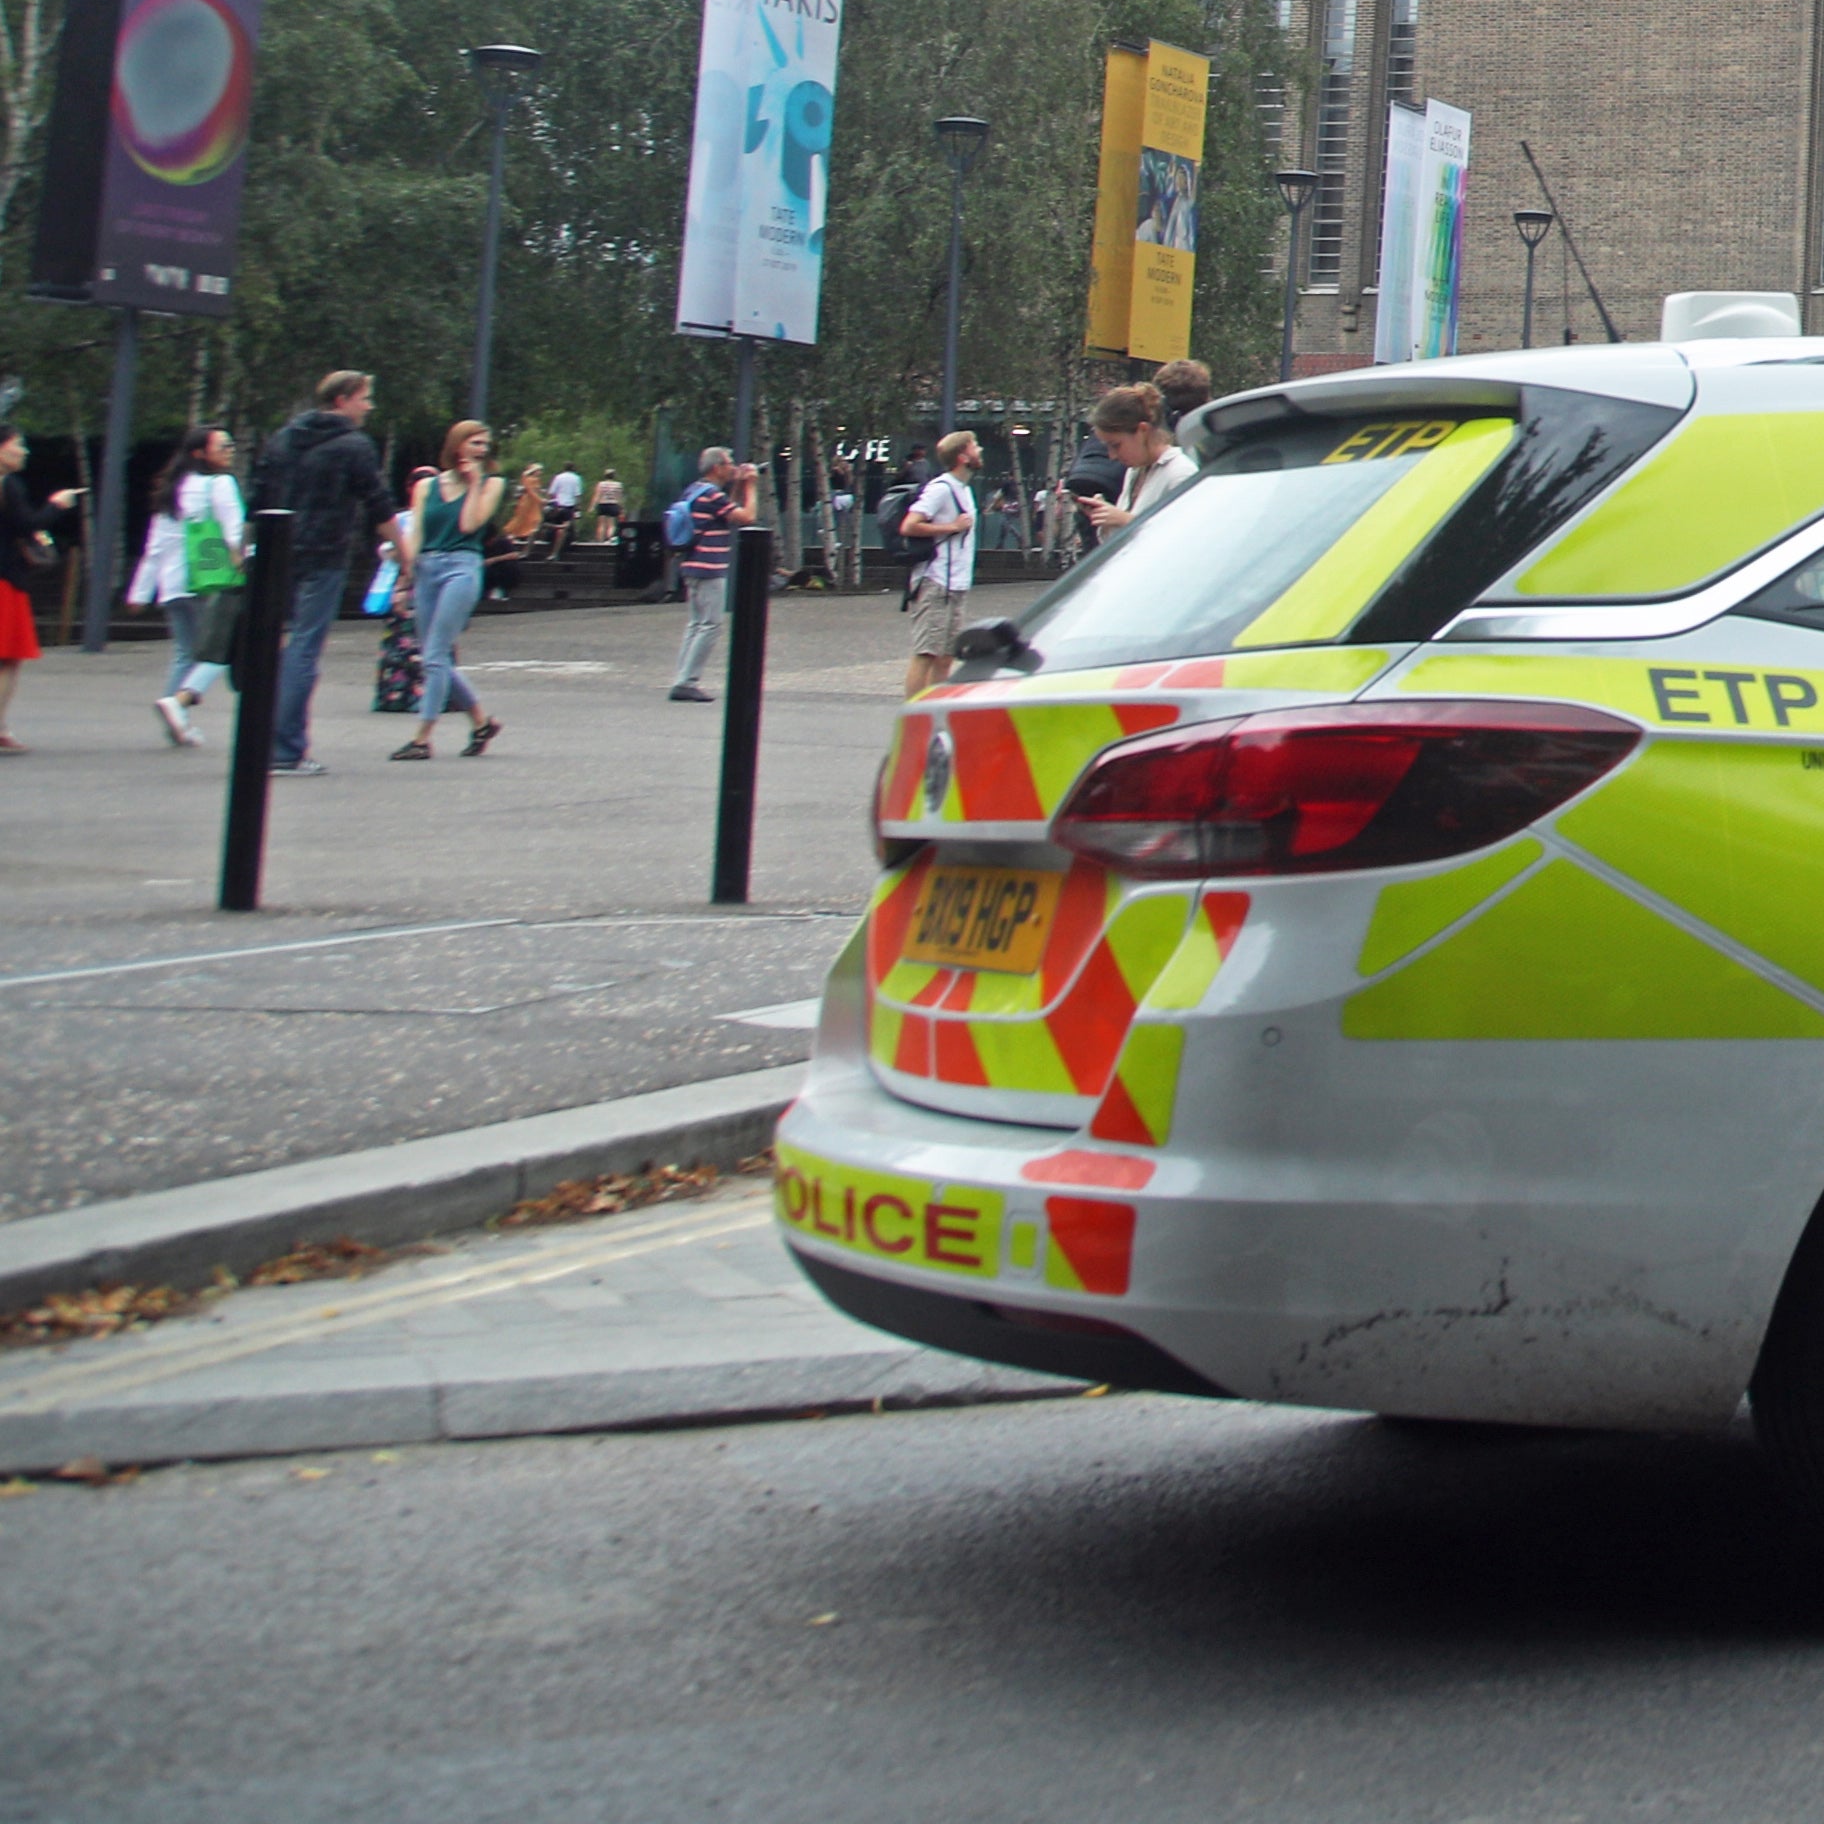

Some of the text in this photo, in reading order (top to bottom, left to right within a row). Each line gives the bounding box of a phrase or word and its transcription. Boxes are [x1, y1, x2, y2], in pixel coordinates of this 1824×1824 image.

[1320, 420, 1458, 465] ETP
[1647, 667, 1818, 727] ETP
[778, 1167, 983, 1268] OLICE
